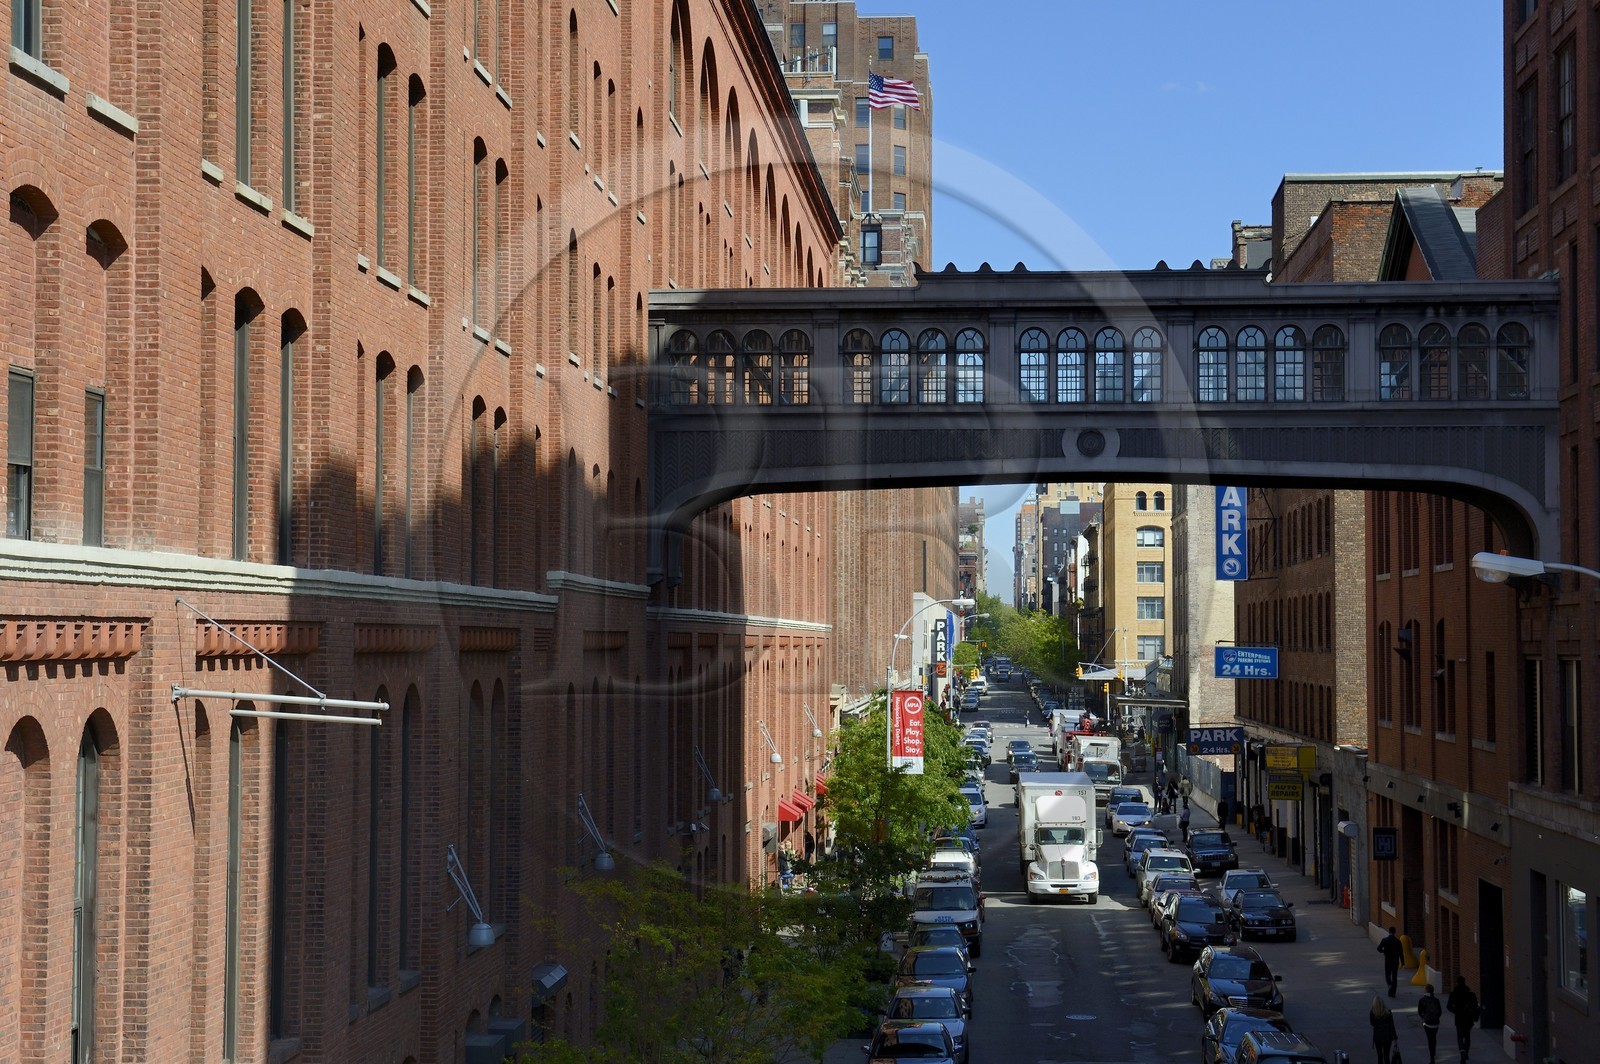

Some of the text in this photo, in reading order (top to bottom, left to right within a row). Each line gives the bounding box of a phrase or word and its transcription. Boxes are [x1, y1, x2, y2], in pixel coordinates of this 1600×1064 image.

[936, 621, 947, 662] PARK
[1237, 650, 1271, 660] ENTERPRISE
[1222, 664, 1271, 676] 24 Hrs.
[893, 696, 901, 728] Meatpacking
[905, 728, 922, 737] Play.
[1190, 729, 1239, 742] PARK
[903, 737, 922, 746] Shop.
[905, 746, 922, 755] Stay.
[1271, 790, 1300, 798] REPAIRS
